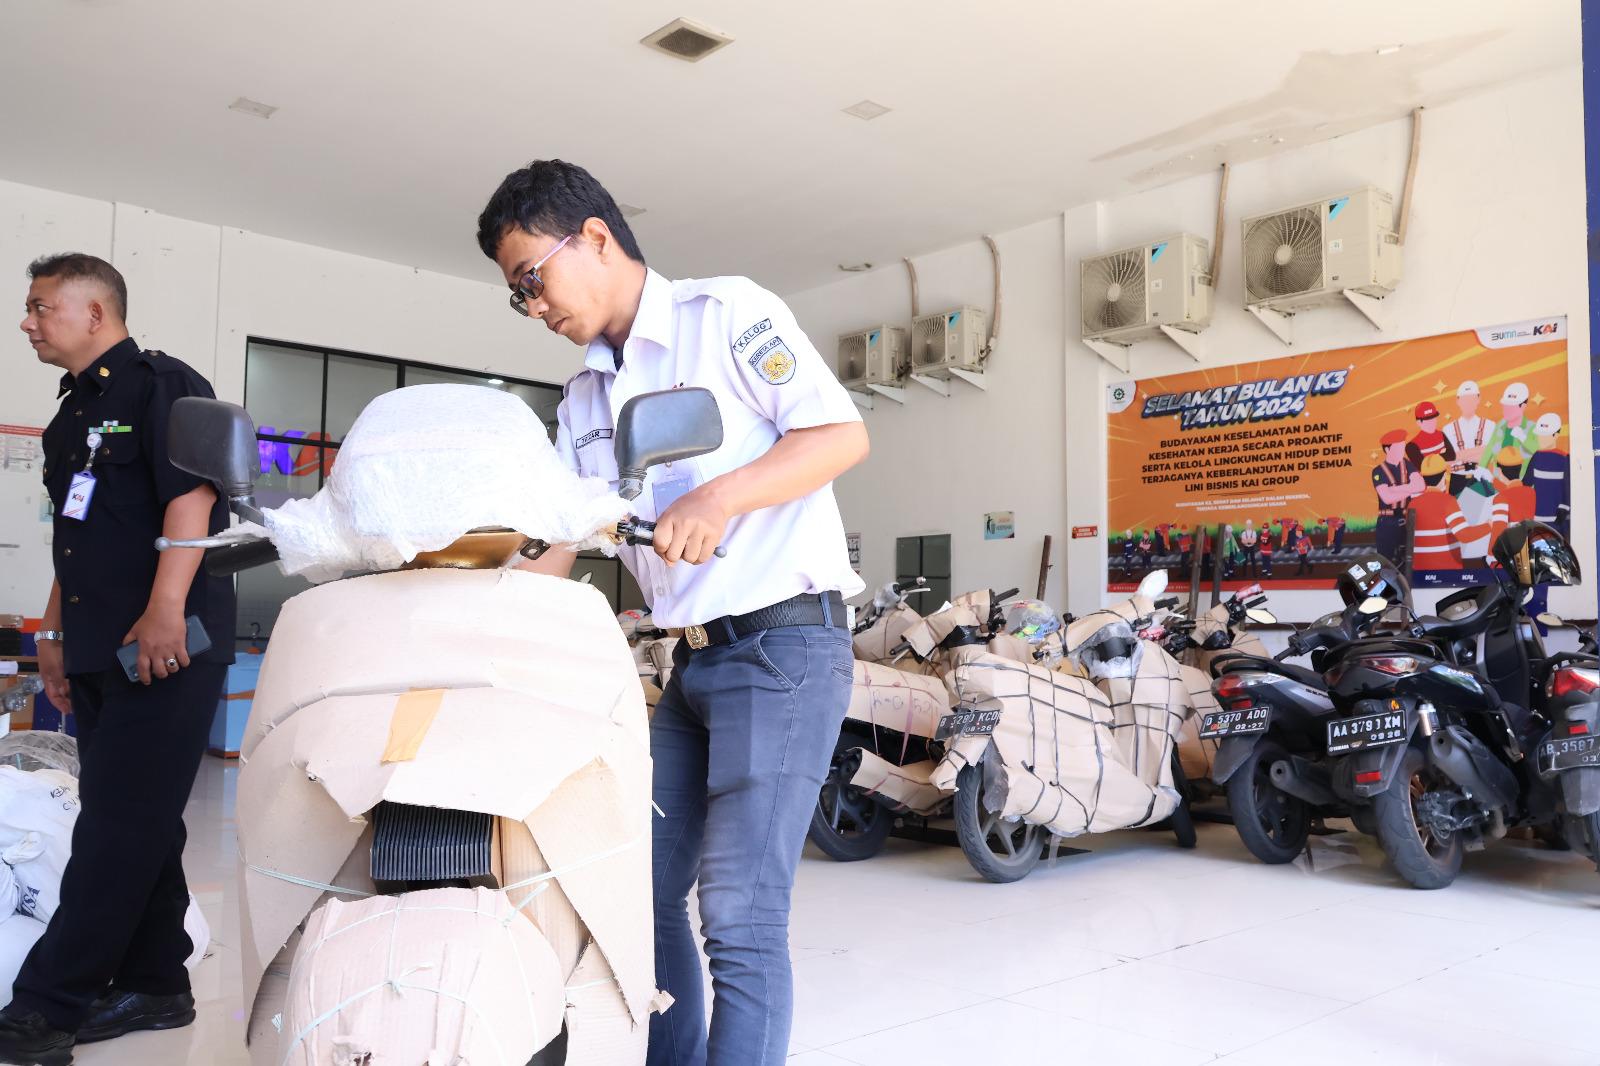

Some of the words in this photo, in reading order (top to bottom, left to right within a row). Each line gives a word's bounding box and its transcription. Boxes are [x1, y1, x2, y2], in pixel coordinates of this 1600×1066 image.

[738, 323, 766, 348] KALOG
[1144, 384, 1239, 416] SELAMAT
[1238, 375, 1313, 401] BULAN
[1314, 369, 1348, 395] K3
[1181, 401, 1251, 429] TAHUN
[1251, 395, 1306, 420] 2024
[1149, 448, 1205, 461] KESEHATAN
[1208, 444, 1240, 455] KERJA
[1242, 440, 1284, 451] SECARA
[1287, 433, 1343, 446] PROAKTIF
[1160, 434, 1221, 448] BUDAYAKAN
[1223, 426, 1301, 441] KESELAMATAN
[1303, 422, 1328, 433] DAN
[258, 425, 340, 477] KA
[1142, 463, 1171, 473] SERTA
[1174, 459, 1211, 470] KELOLA
[1214, 452, 1282, 466] LINGKUNGAN
[1285, 449, 1319, 459] HIDUP
[1323, 445, 1352, 456] DEMI
[1142, 471, 1203, 484] TERJAGANYA
[1206, 463, 1295, 479] KEBERLANJUTAN
[1298, 462, 1309, 471] DI
[1312, 458, 1352, 470] SEMUA
[1184, 483, 1203, 492] LINI
[1206, 480, 1239, 490] BISNIS
[1241, 478, 1260, 488] KAI
[1262, 475, 1300, 486] GROUP
[1217, 712, 1242, 724] 5370
[1333, 724, 1348, 737] AA
[1384, 715, 1401, 730] XM
